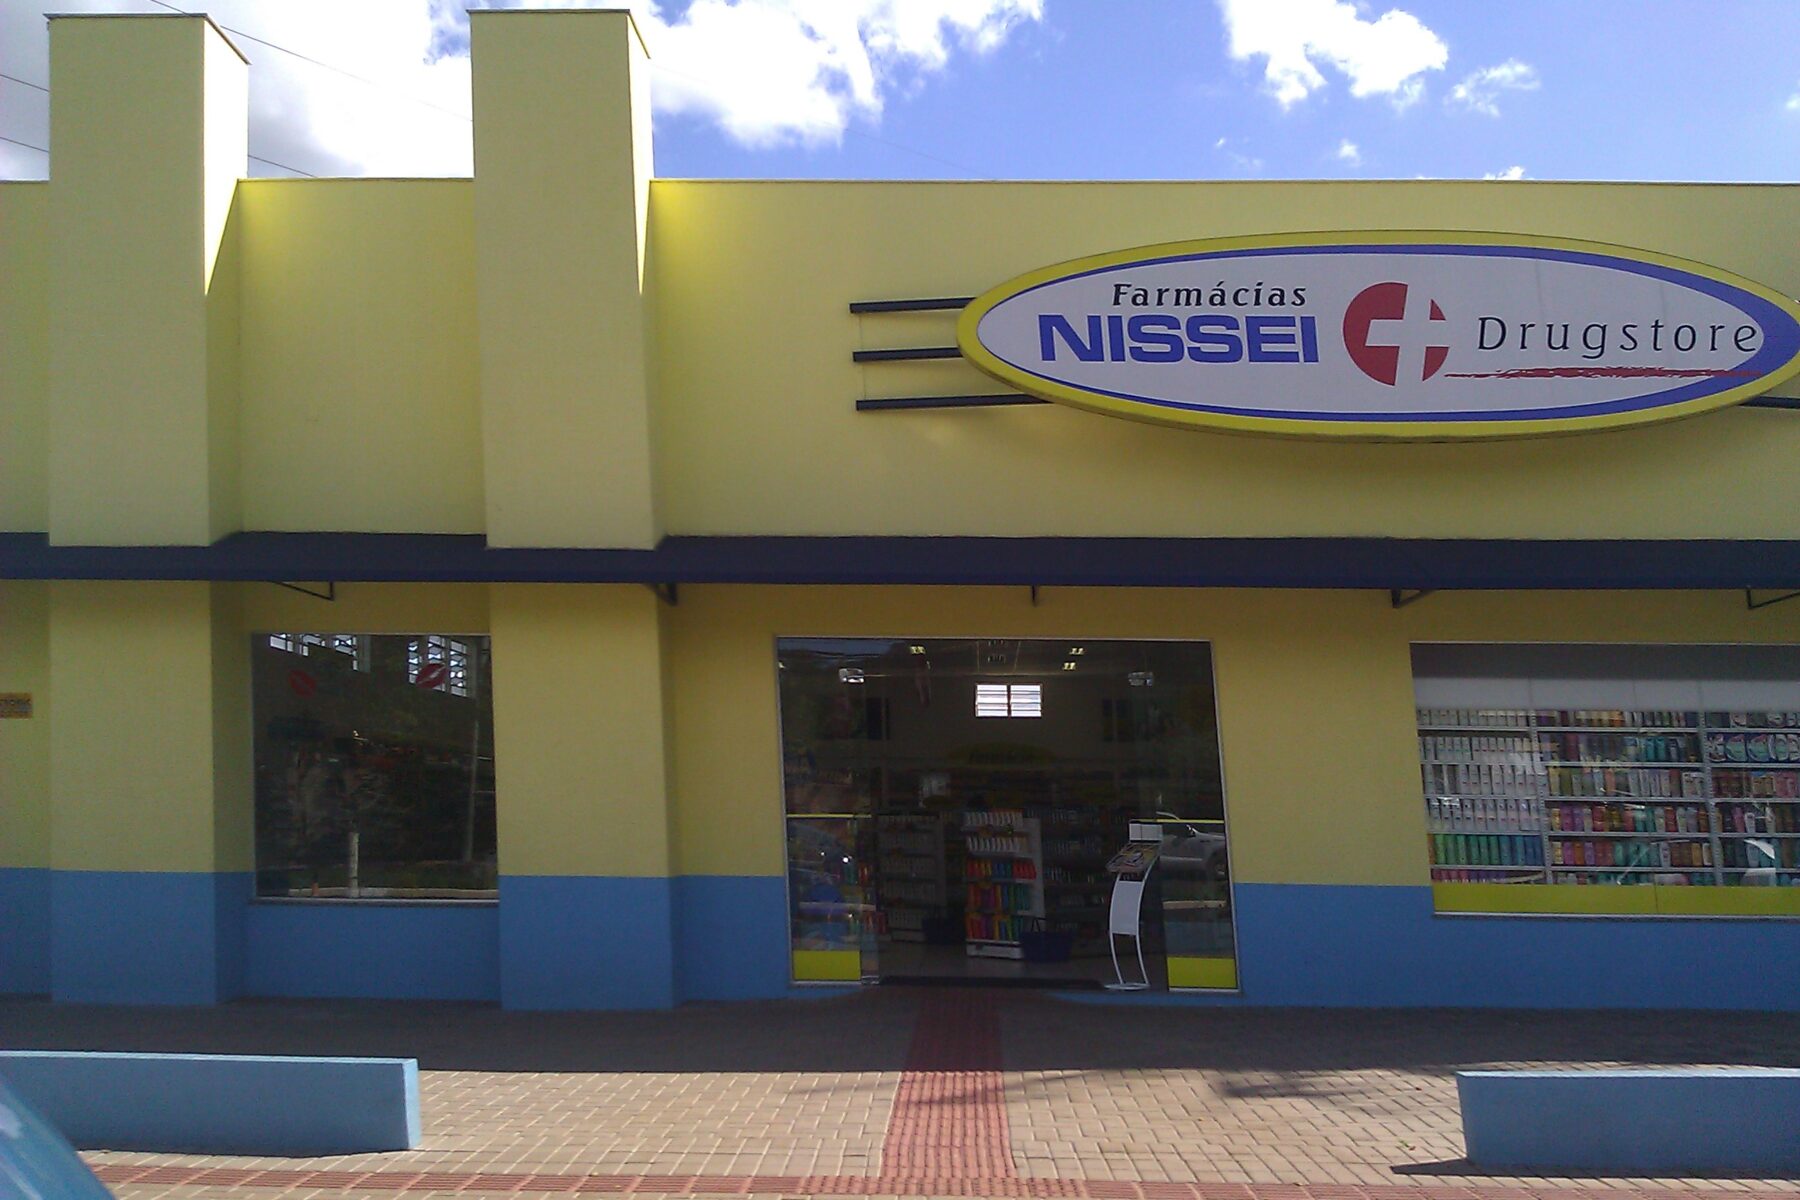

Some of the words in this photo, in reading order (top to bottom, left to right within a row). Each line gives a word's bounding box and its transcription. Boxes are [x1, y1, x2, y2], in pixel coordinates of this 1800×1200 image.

[1112, 281, 1307, 306] Farmácias
[1038, 314, 1319, 363] NISSEI
[1477, 316, 1758, 359] Drugstore
